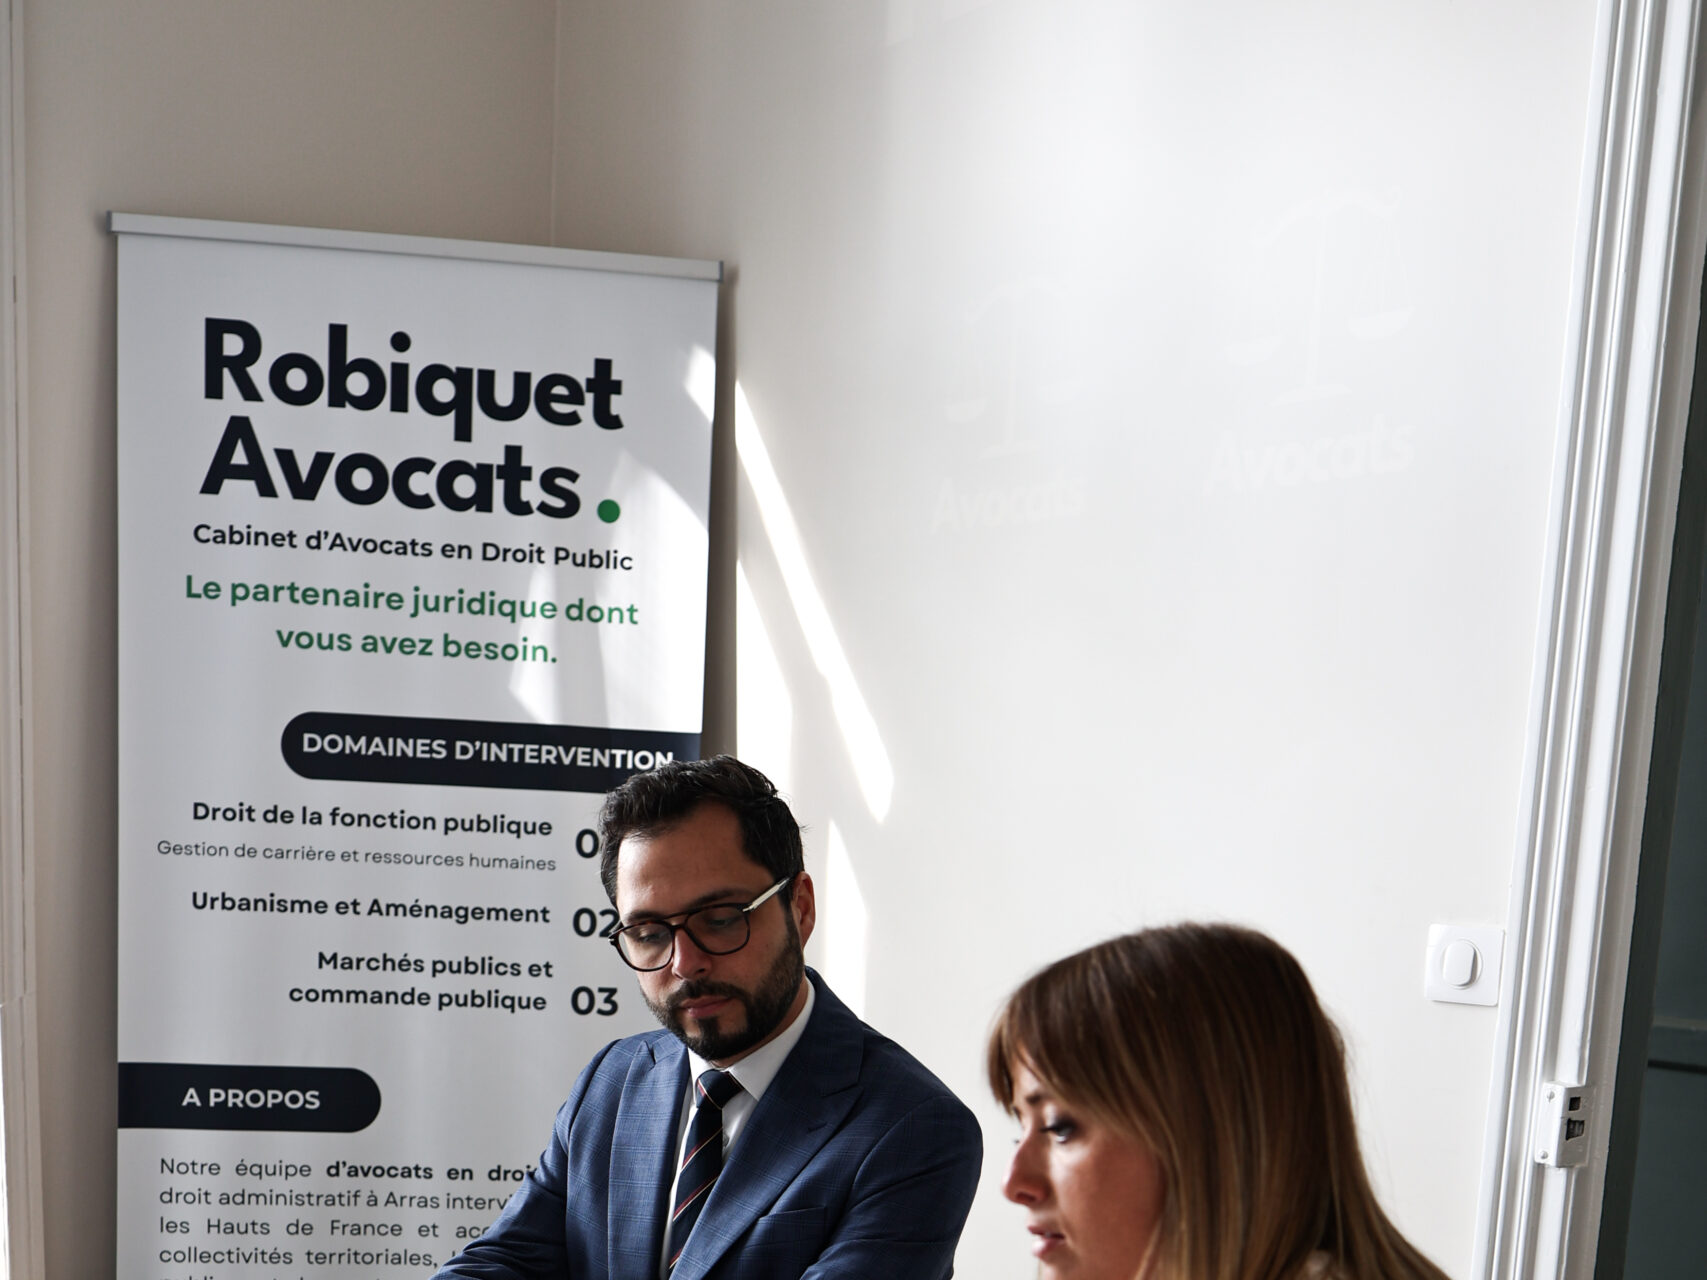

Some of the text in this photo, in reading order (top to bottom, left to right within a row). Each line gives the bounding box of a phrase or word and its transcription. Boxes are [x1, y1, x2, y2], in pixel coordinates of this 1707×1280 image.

[204, 317, 624, 443] Robiquet
[193, 524, 634, 571] Cabinet d’Avocats en Droit Public
[185, 574, 639, 625] Le partenaire juridique dont
[276, 627, 558, 664] vous avez besoin.
[302, 731, 447, 760] DOMAINES
[192, 802, 600, 858] Droit de la fonction publique 0
[157, 840, 557, 872] Gestion de carrière et ressources humaines
[192, 891, 620, 938] Urbanisme et Aménagement 02
[318, 951, 553, 982] Marchés publics et
[289, 984, 619, 1016] commande publique 03
[182, 1086, 321, 1110] A PROPOS
[160, 1158, 221, 1176] Notre
[235, 1159, 312, 1181] équipe
[326, 1161, 433, 1179] d’avocats
[447, 1167, 473, 1181] en
[160, 1187, 512, 1210] droit administratif à Arras interv
[160, 1217, 190, 1234] les
[207, 1218, 271, 1235] Hauts
[286, 1219, 314, 1236] de
[331, 1219, 403, 1236] France
[418, 1223, 439, 1238] et
[159, 1247, 437, 1268] collectivités territoriales,
